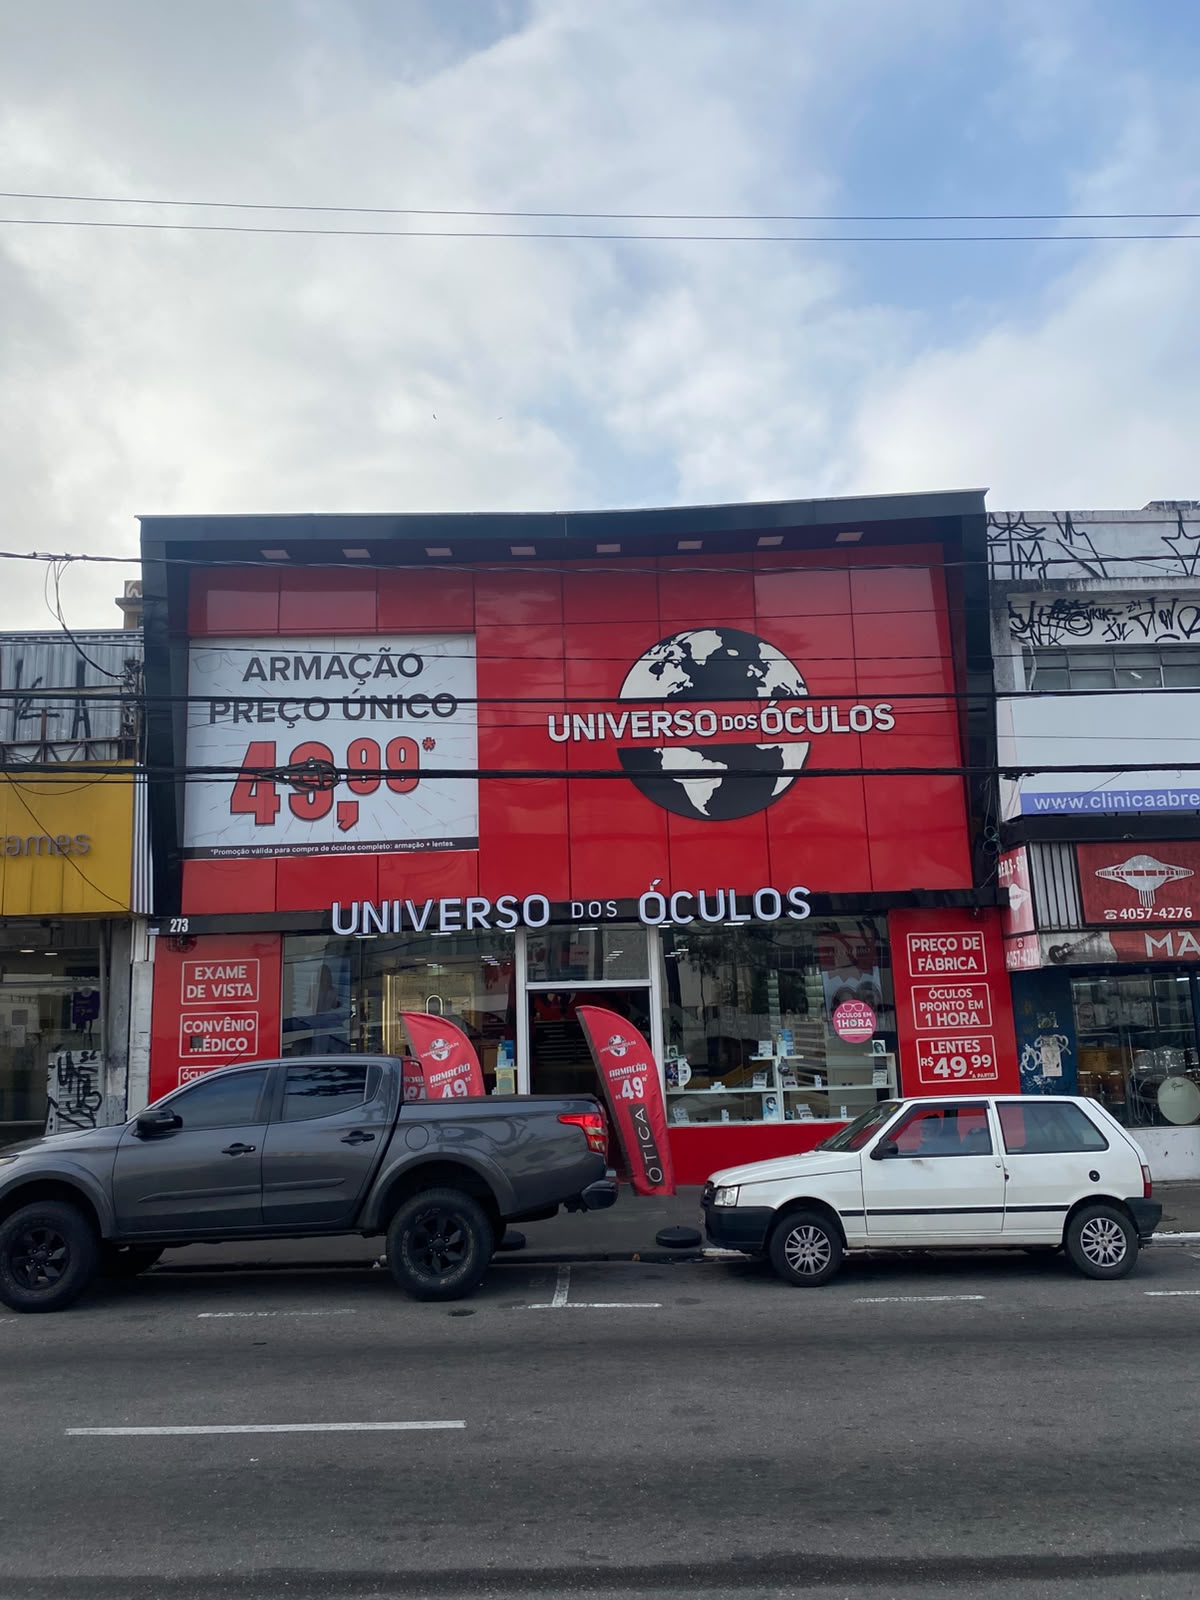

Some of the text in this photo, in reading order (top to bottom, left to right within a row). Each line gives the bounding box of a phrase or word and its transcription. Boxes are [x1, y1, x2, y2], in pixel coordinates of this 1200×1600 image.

[242, 647, 424, 685] ARMAÇÃO
[209, 689, 458, 729] PREÇO ÚNICO
[547, 700, 895, 742] UNIVERSO DOS ÓCULOS
[251, 846, 273, 856] válida
[274, 846, 290, 856] para
[291, 845, 319, 855] compra
[320, 843, 330, 853] de
[331, 842, 355, 853] óculos
[357, 841, 392, 853] completo:
[394, 841, 424, 851] armação
[331, 878, 812, 936] UNIVERSO DOS ÓCULOS
[1119, 908, 1193, 921] 4057-4276
[169, 918, 189, 933] 273
[911, 936, 981, 956] PREÇO DE
[918, 955, 978, 972] FÁBRICA
[194, 966, 247, 980] EXAME
[187, 983, 253, 998] DE VISTA
[929, 987, 973, 1000] ÓCULOS
[836, 1010, 862, 1019] ÓCULOS
[919, 1000, 984, 1013] PRONTO EM
[183, 1016, 255, 1034] CONVÊNIO
[925, 1012, 981, 1028] 1 HORA
[190, 1035, 248, 1053] ÉDICO
[930, 1040, 981, 1055] LENTES
[920, 1056, 934, 1067] R$
[621, 1076, 644, 1100] 49
[635, 1106, 663, 1183] ÓTICA
